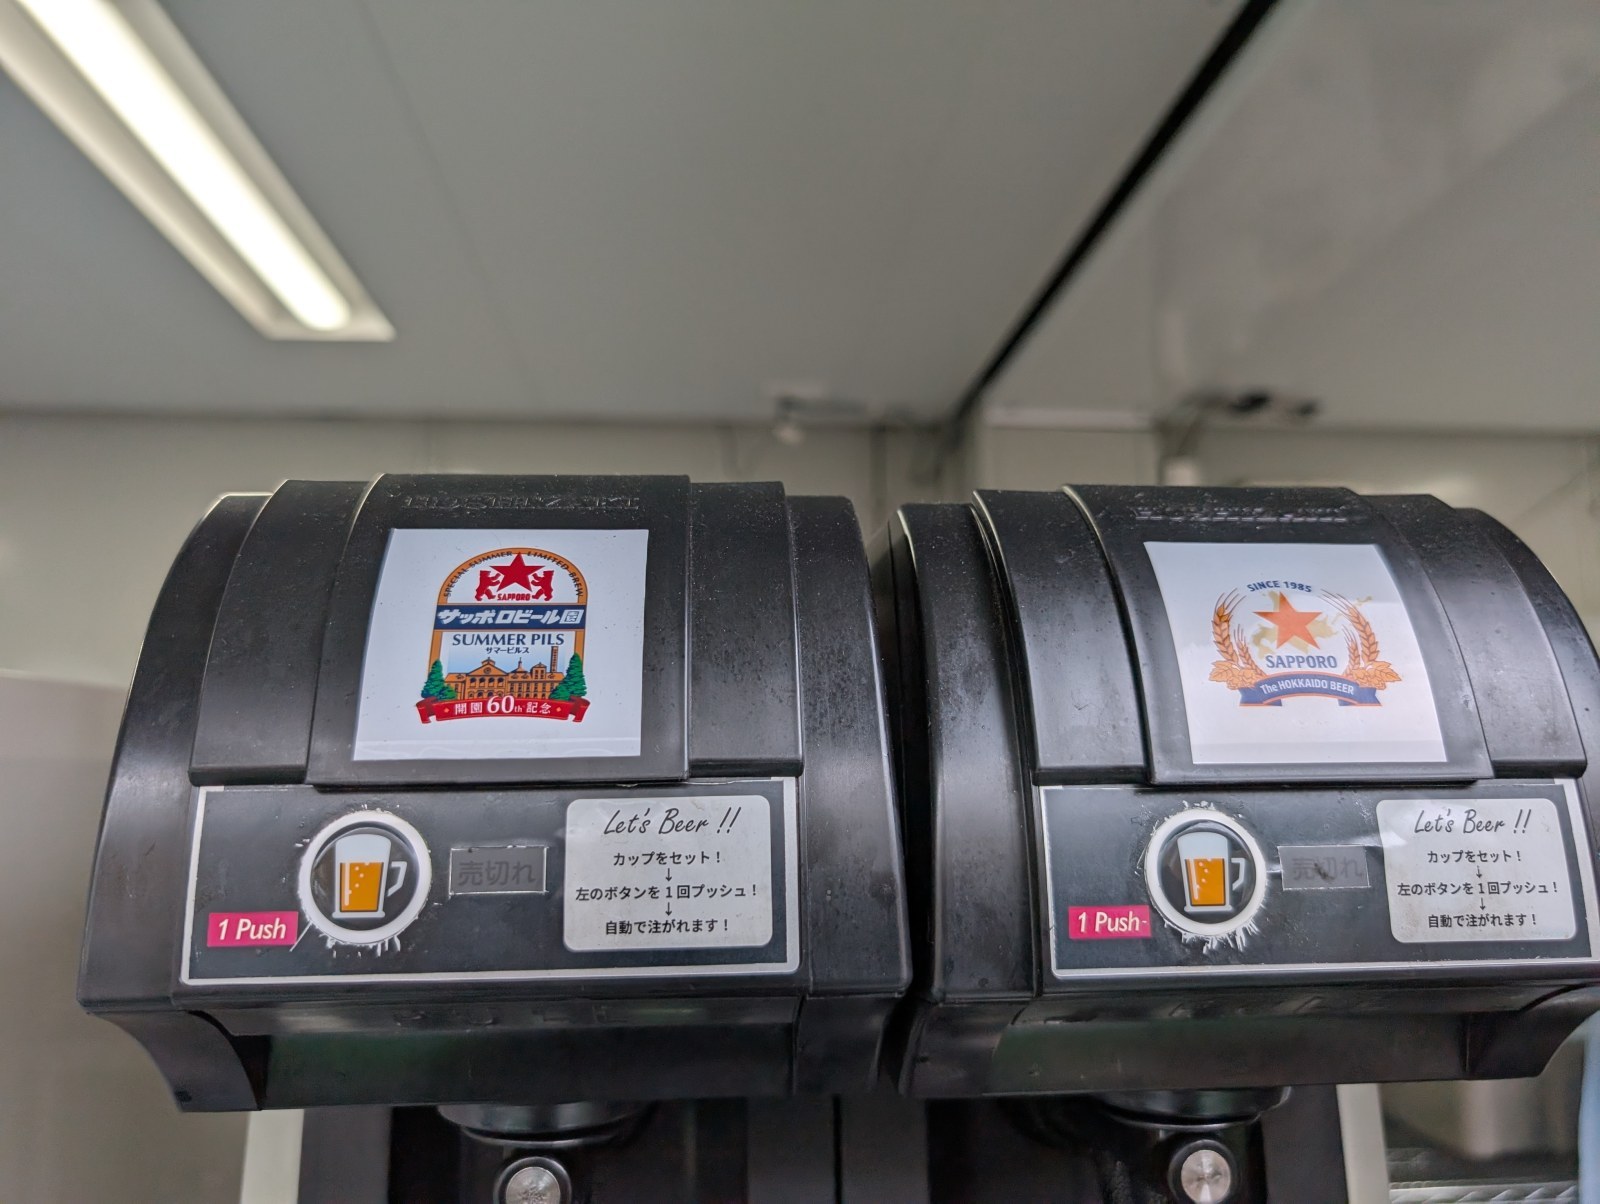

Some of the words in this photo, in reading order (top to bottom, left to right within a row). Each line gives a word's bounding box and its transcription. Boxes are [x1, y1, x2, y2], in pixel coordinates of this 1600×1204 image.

[469, 550, 513, 569] SUMMER
[527, 550, 570, 571] LIMITED
[568, 571, 584, 597] BREW
[1247, 580, 1281, 593] SINCE
[1283, 580, 1313, 594] 1985
[497, 592, 531, 602] SAPPORO
[437, 608, 585, 625] サッポロビール園
[452, 633, 527, 646] SUMMER
[531, 633, 565, 646] PILS
[1265, 655, 1338, 669] SAPPORO
[1259, 684, 1279, 695] The
[1279, 679, 1328, 691] HOKKAIDO
[1329, 681, 1355, 695] BEER
[603, 807, 651, 835] Let's
[658, 807, 709, 835] Beer
[1414, 808, 1455, 834] Let's
[1462, 808, 1506, 834] Beer
[613, 851, 721, 866] カップをセット！
[1427, 850, 1522, 864] カップをセット！
[457, 860, 536, 887] 売切れ
[218, 919, 229, 941] 1
[235, 917, 287, 941] Push
[605, 918, 728, 935] 自動で注がれます！
[1077, 912, 1087, 933] 1
[1428, 913, 1537, 929] 自動で注がれます！
